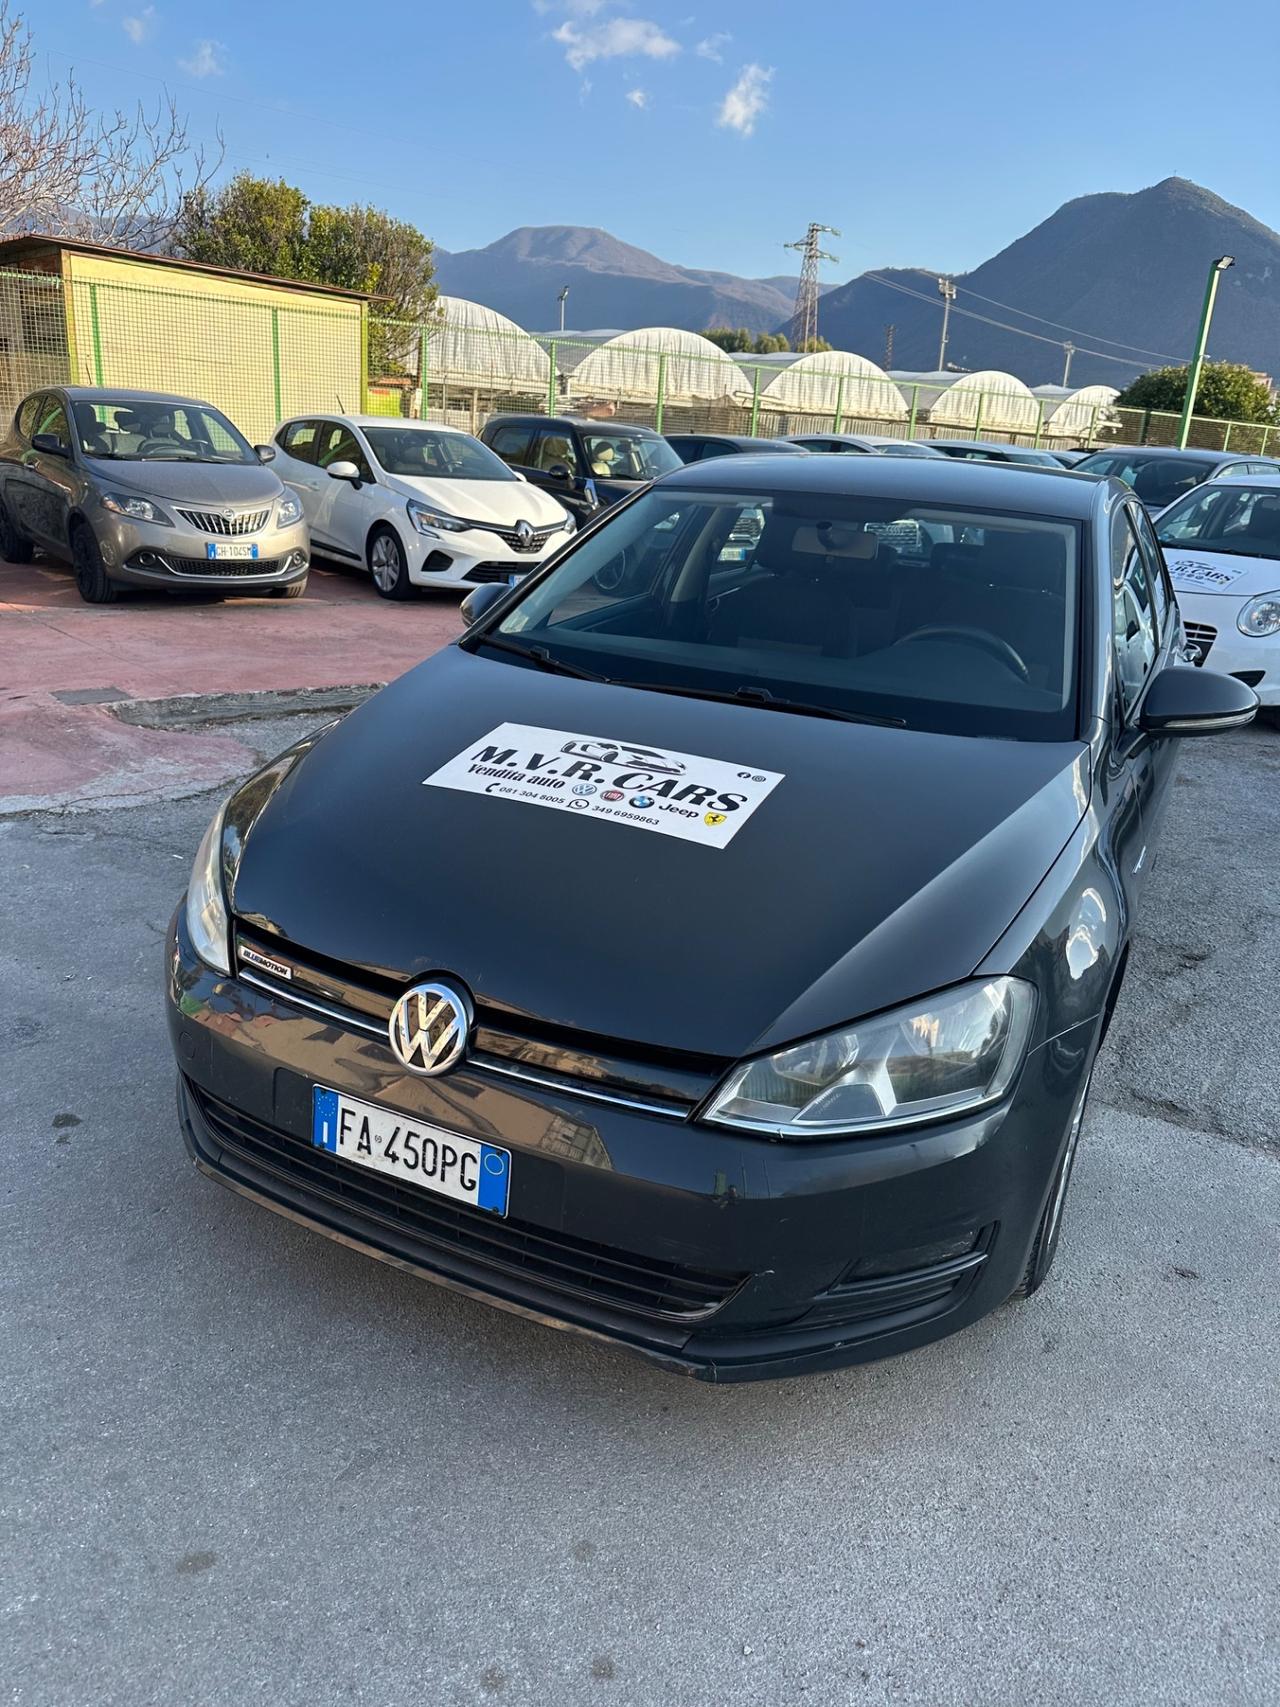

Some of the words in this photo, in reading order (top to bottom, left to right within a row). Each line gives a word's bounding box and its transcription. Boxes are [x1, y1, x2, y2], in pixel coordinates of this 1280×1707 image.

[468, 763, 526, 782] Vendita
[526, 775, 566, 790] auto
[499, 786, 517, 795] 081
[519, 791, 538, 799] 304
[539, 795, 566, 804] 8005
[592, 805, 613, 815] 349
[613, 810, 660, 826] 6959863
[659, 803, 699, 818] Jeep
[243, 949, 288, 976] BLUEMOTION
[339, 1108, 371, 1155] FA
[384, 1126, 478, 1192] 450PG
